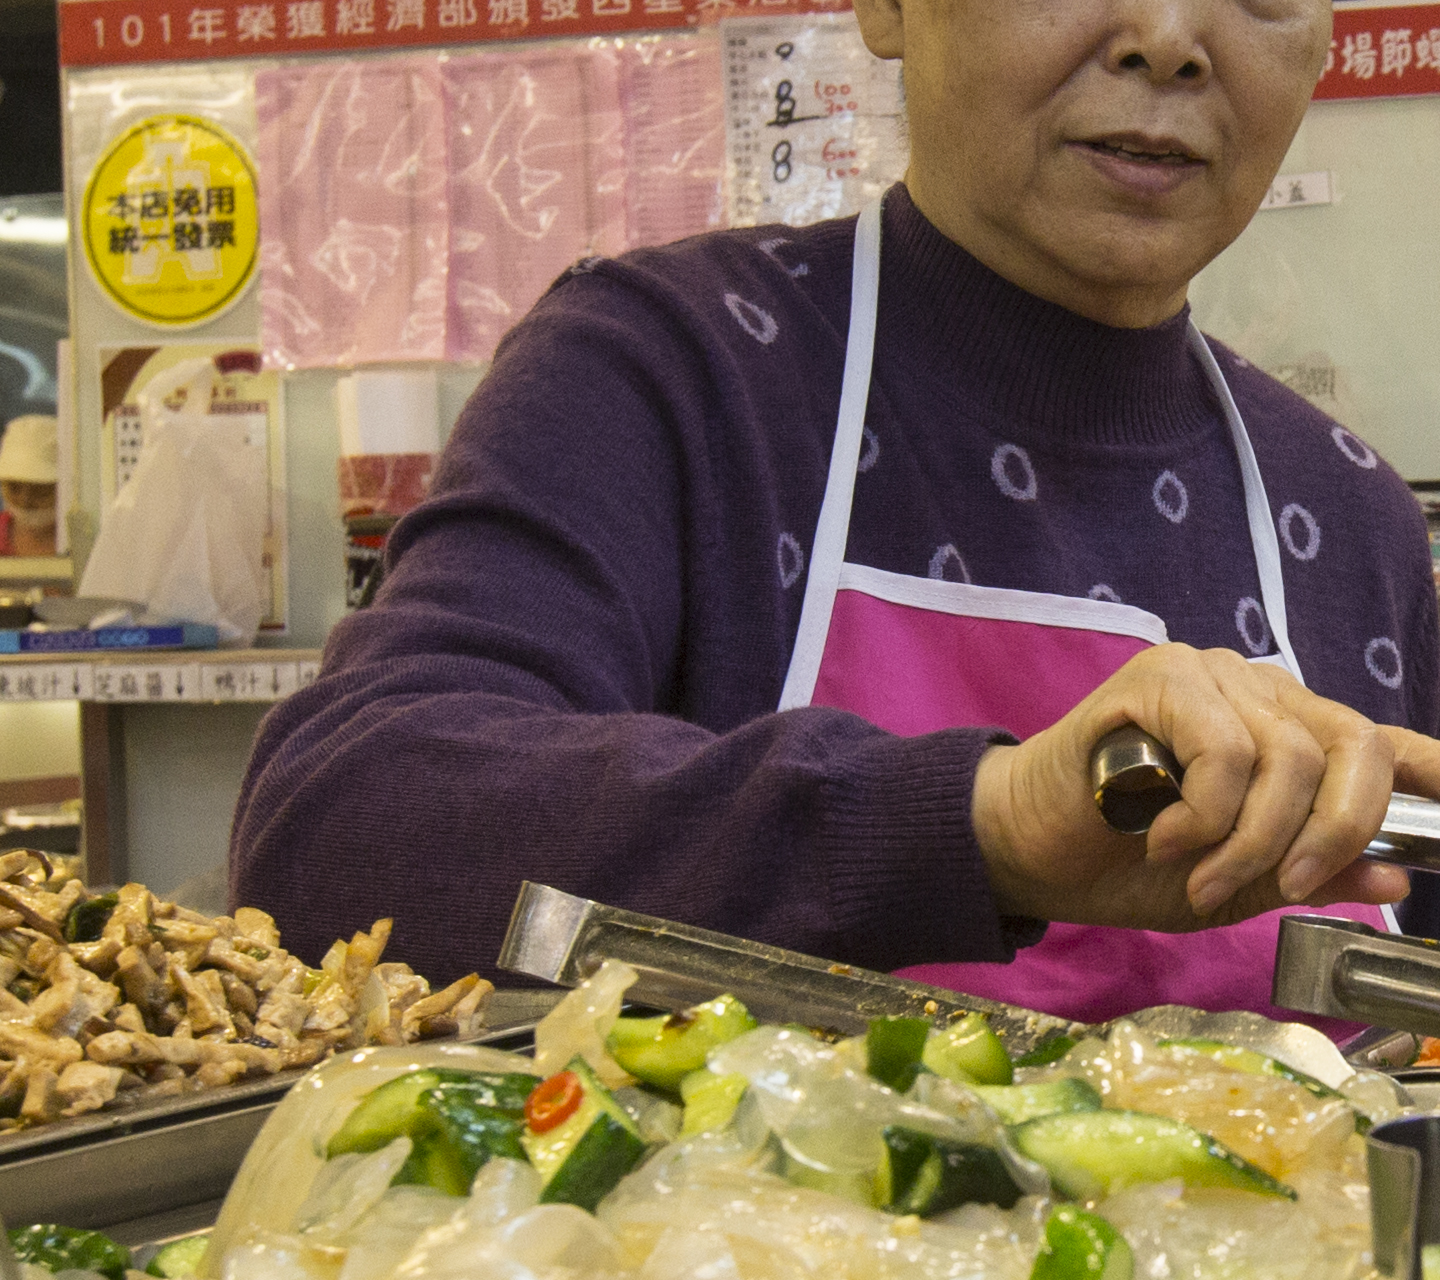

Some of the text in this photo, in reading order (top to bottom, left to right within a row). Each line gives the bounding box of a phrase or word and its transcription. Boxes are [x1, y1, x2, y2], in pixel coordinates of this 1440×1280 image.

[107, 186, 236, 220] 本店免用
[109, 220, 237, 254] 統一發票
